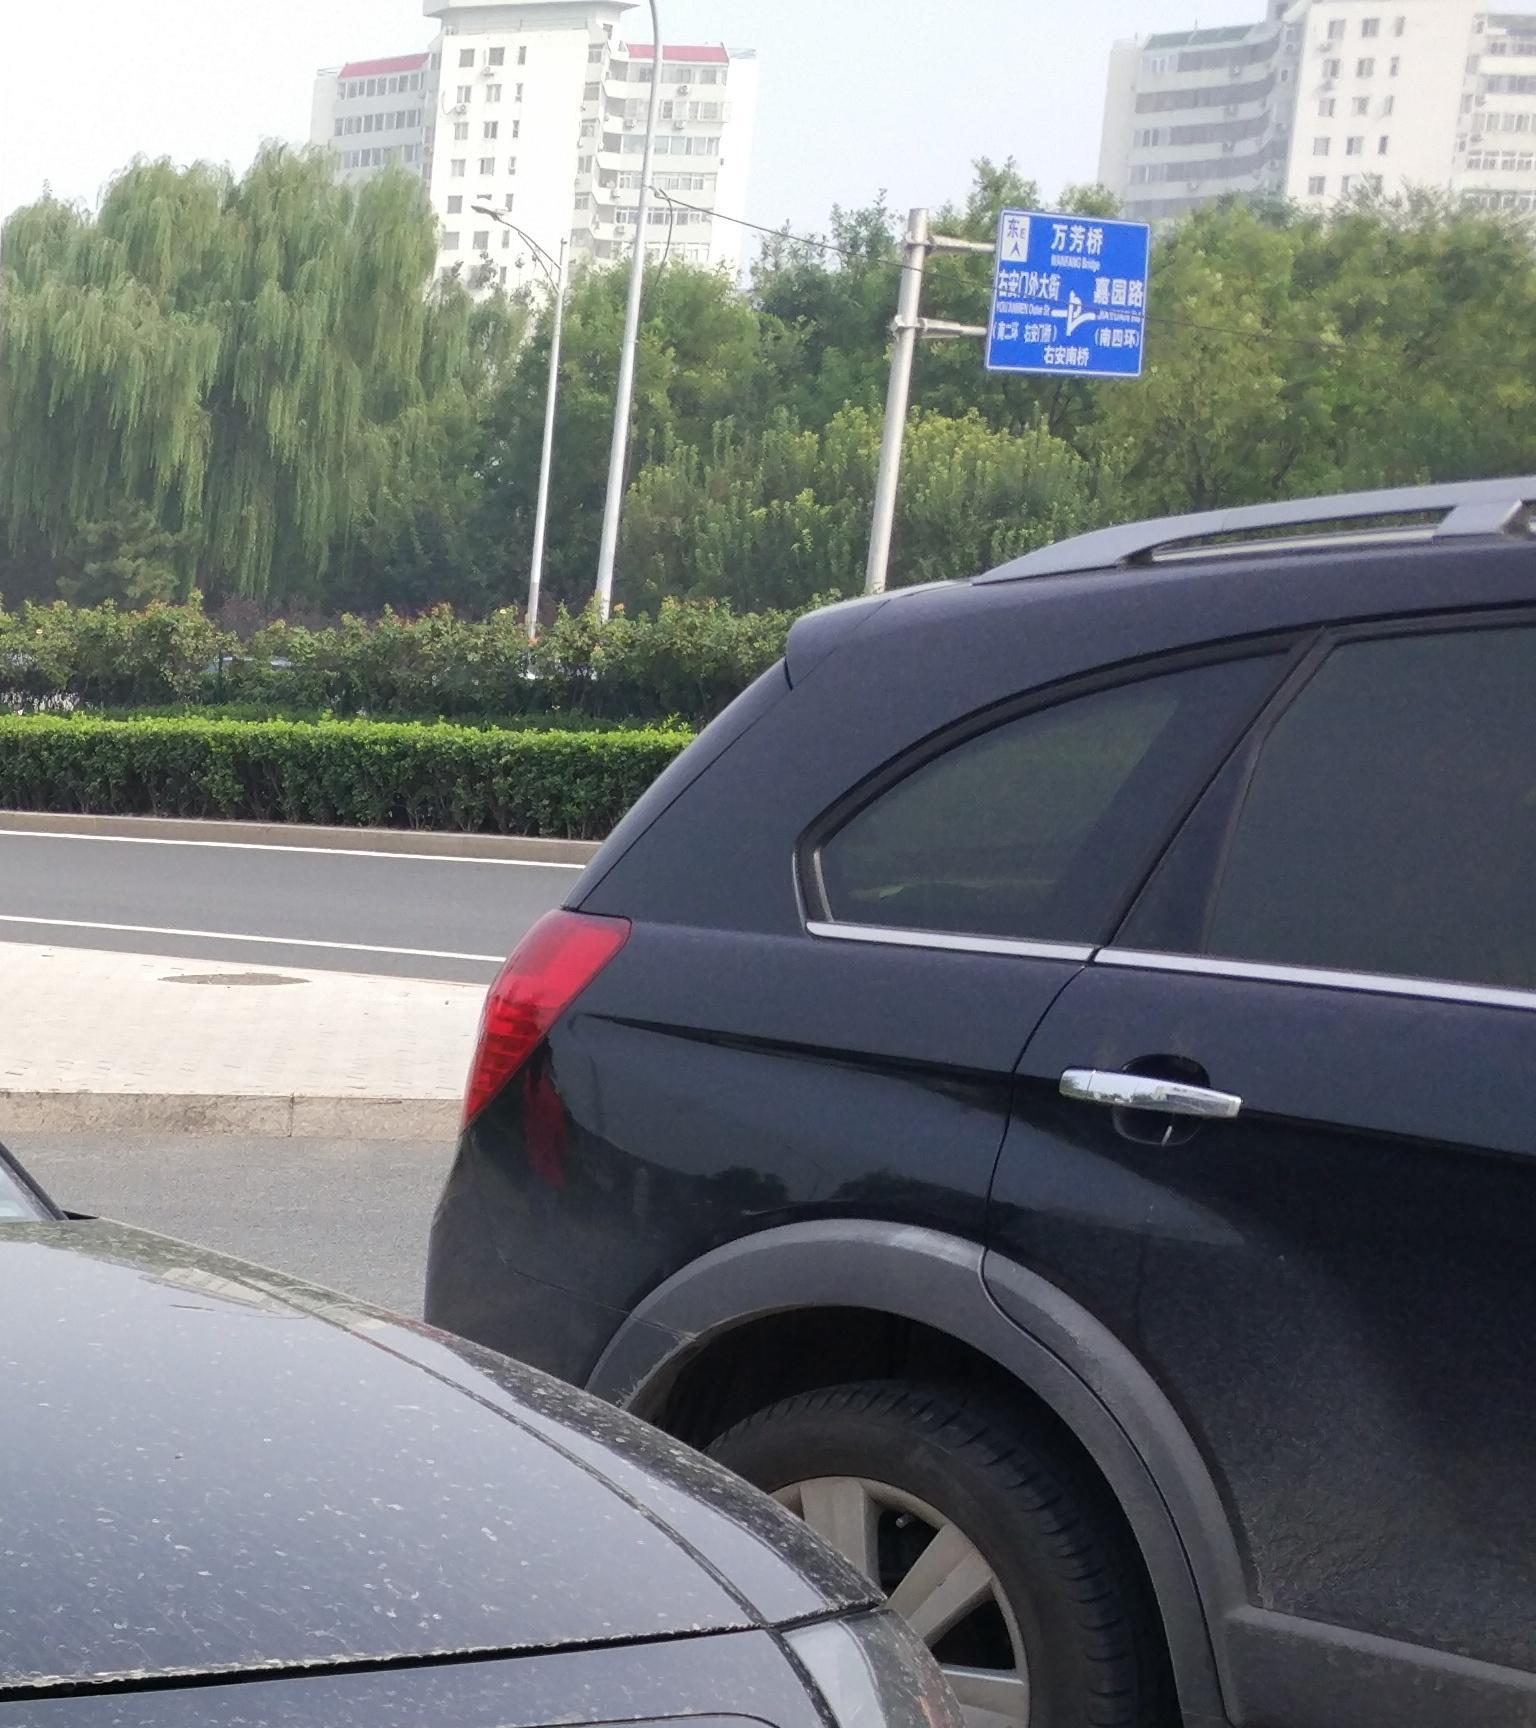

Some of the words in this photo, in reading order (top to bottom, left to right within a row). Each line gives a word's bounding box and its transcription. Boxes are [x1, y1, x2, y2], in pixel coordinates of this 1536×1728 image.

[1050, 223, 1104, 256] 万芳桥
[1093, 277, 1144, 307] 嘉园路
[1043, 345, 1090, 367] 右安南桥
